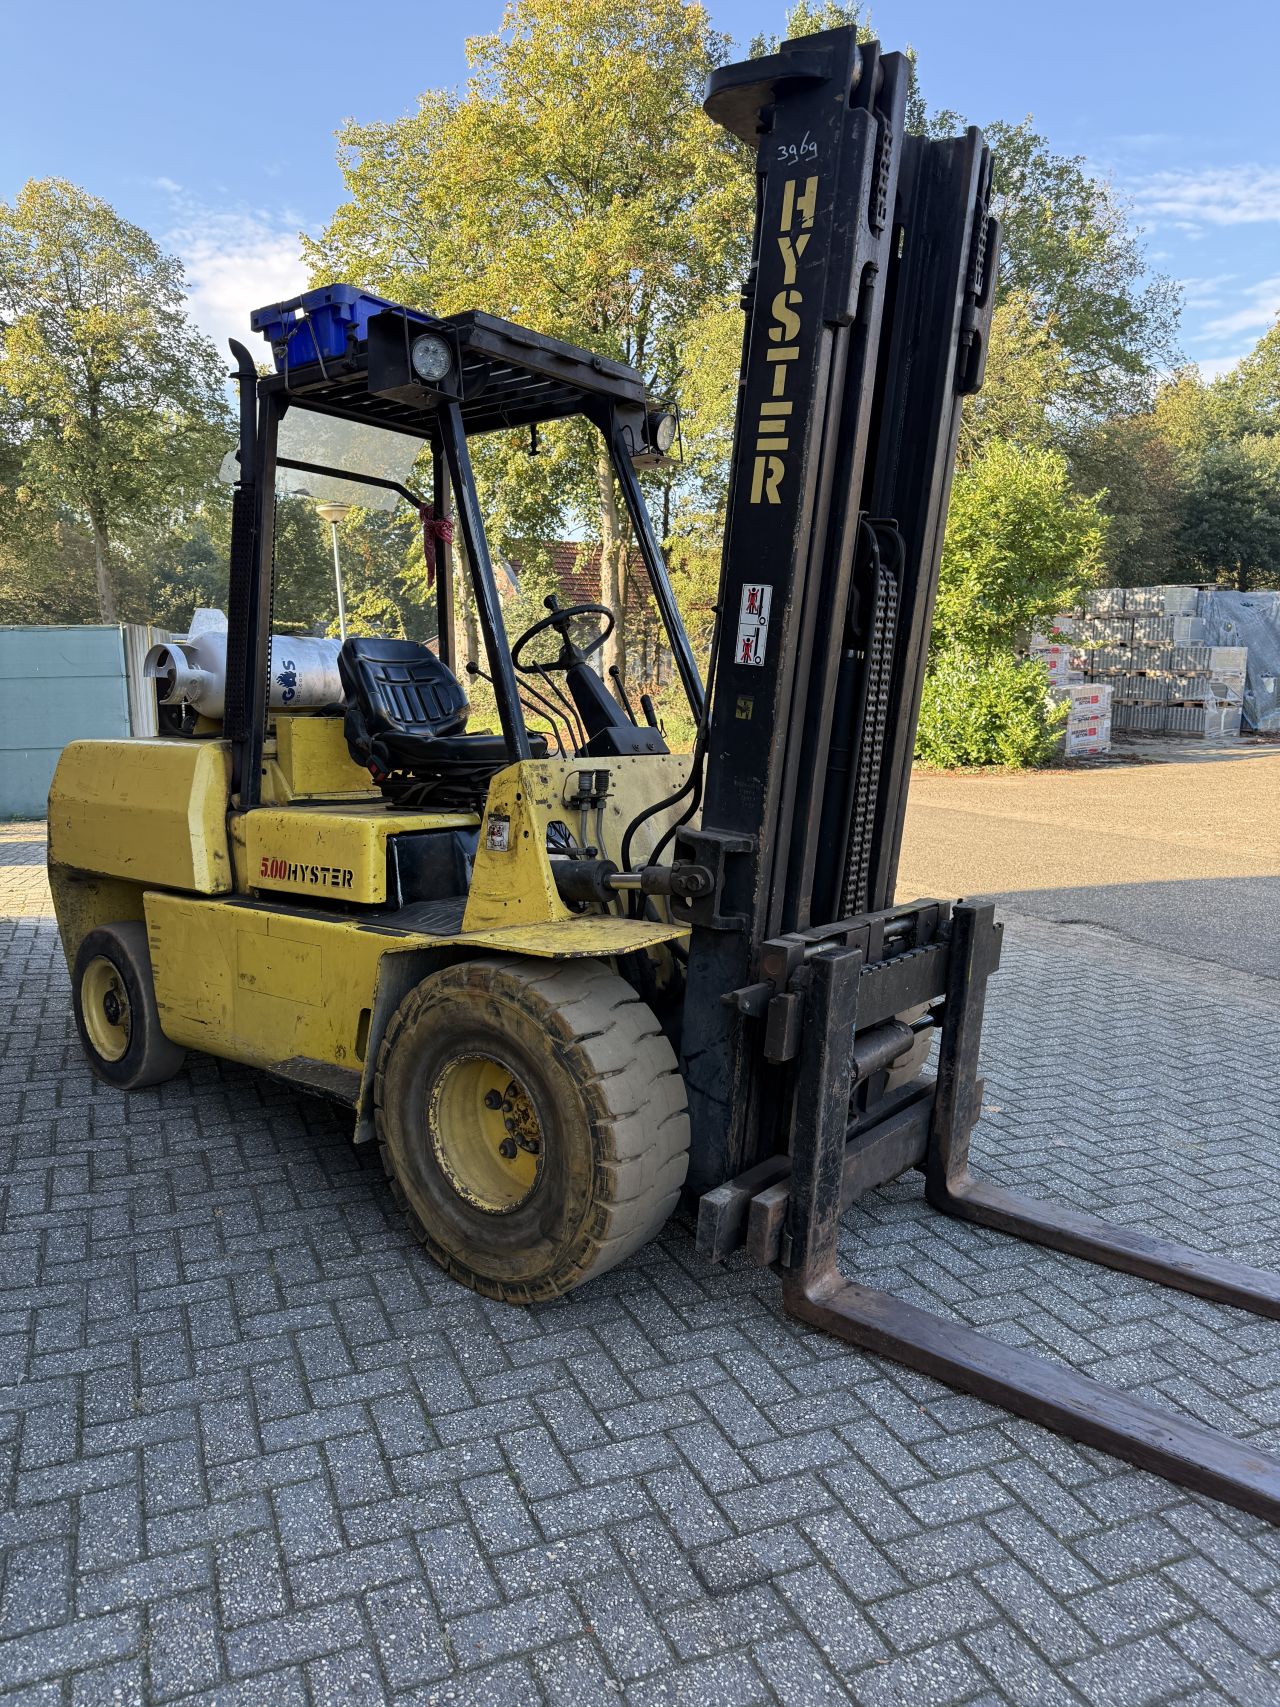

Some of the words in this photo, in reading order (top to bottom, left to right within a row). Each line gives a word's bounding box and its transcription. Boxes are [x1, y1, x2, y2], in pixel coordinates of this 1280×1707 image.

[777, 130, 818, 166] 3969
[750, 175, 819, 504] HYSTER
[260, 856, 287, 880] 5.00
[287, 863, 354, 889] HYSTER
